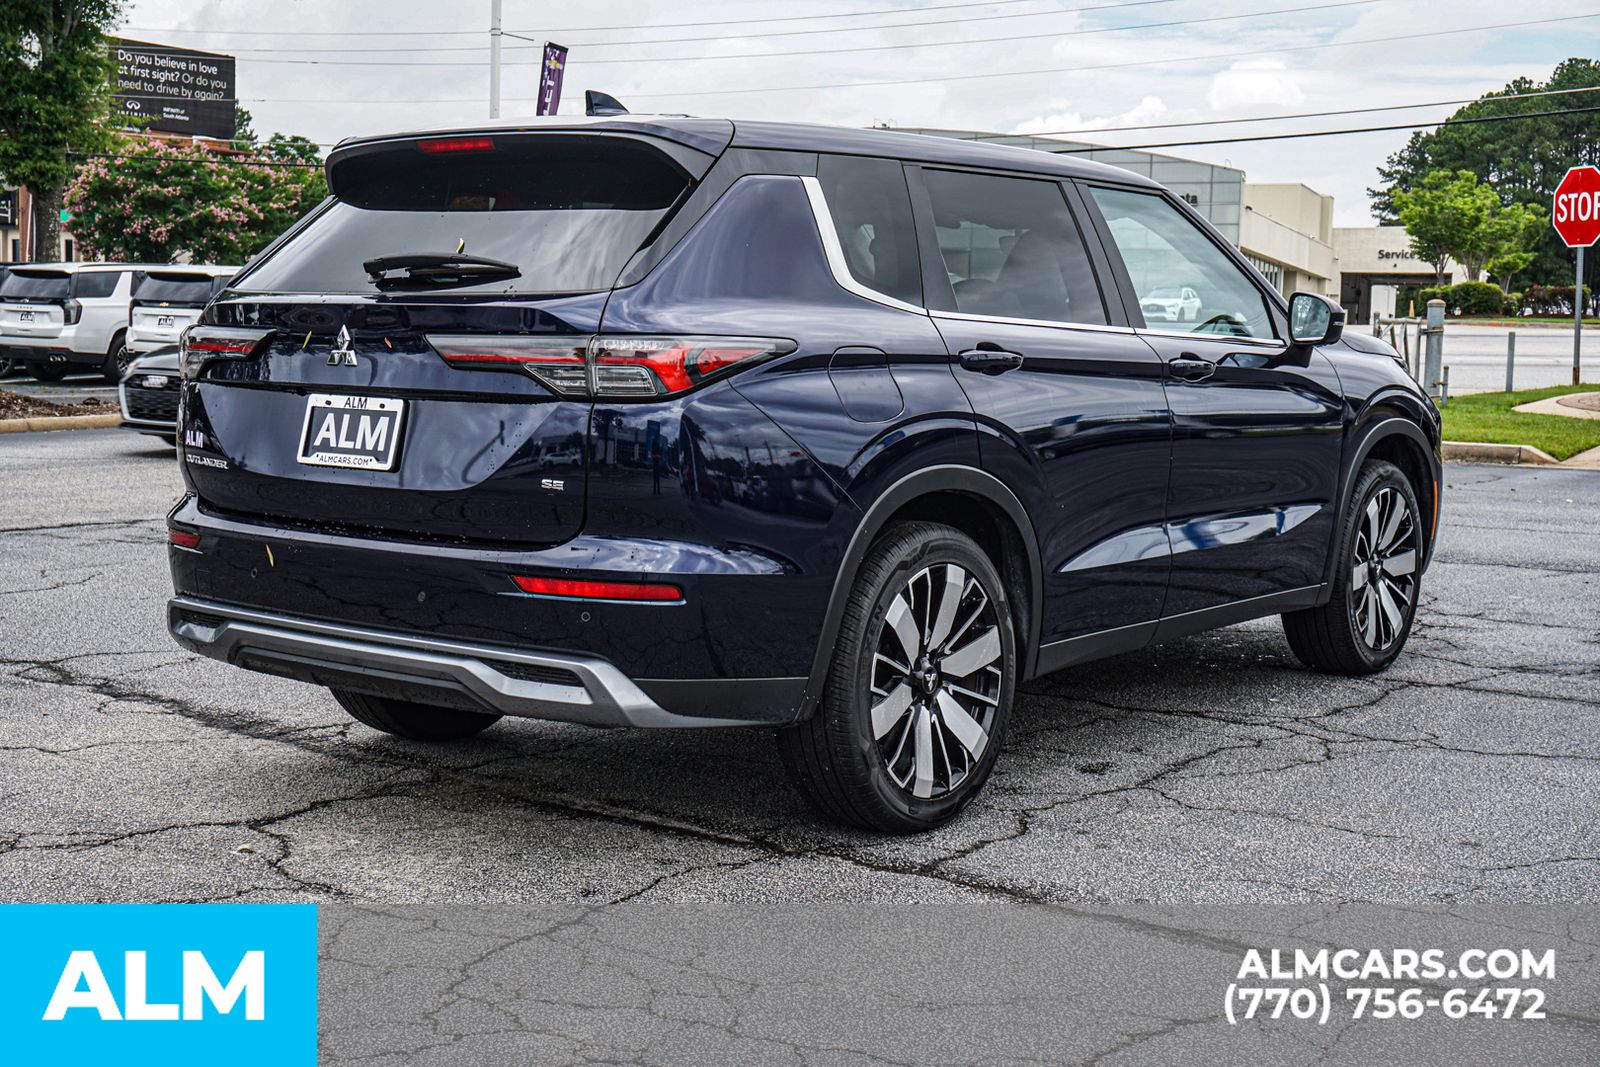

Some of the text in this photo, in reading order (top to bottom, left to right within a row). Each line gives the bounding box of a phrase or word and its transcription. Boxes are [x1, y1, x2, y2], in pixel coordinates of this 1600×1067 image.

[118, 49, 218, 75] Do you believe in love
[118, 64, 227, 90] at first sight? Or do you
[118, 79, 224, 101] need to drive by again?
[1377, 249, 1416, 260] Service
[344, 397, 368, 409] ALM
[185, 430, 203, 449] ALM
[313, 412, 390, 452] ALM
[186, 454, 229, 470] OUTLANDER
[318, 455, 369, 466] ALMCARS.COM
[541, 479, 564, 491] SE
